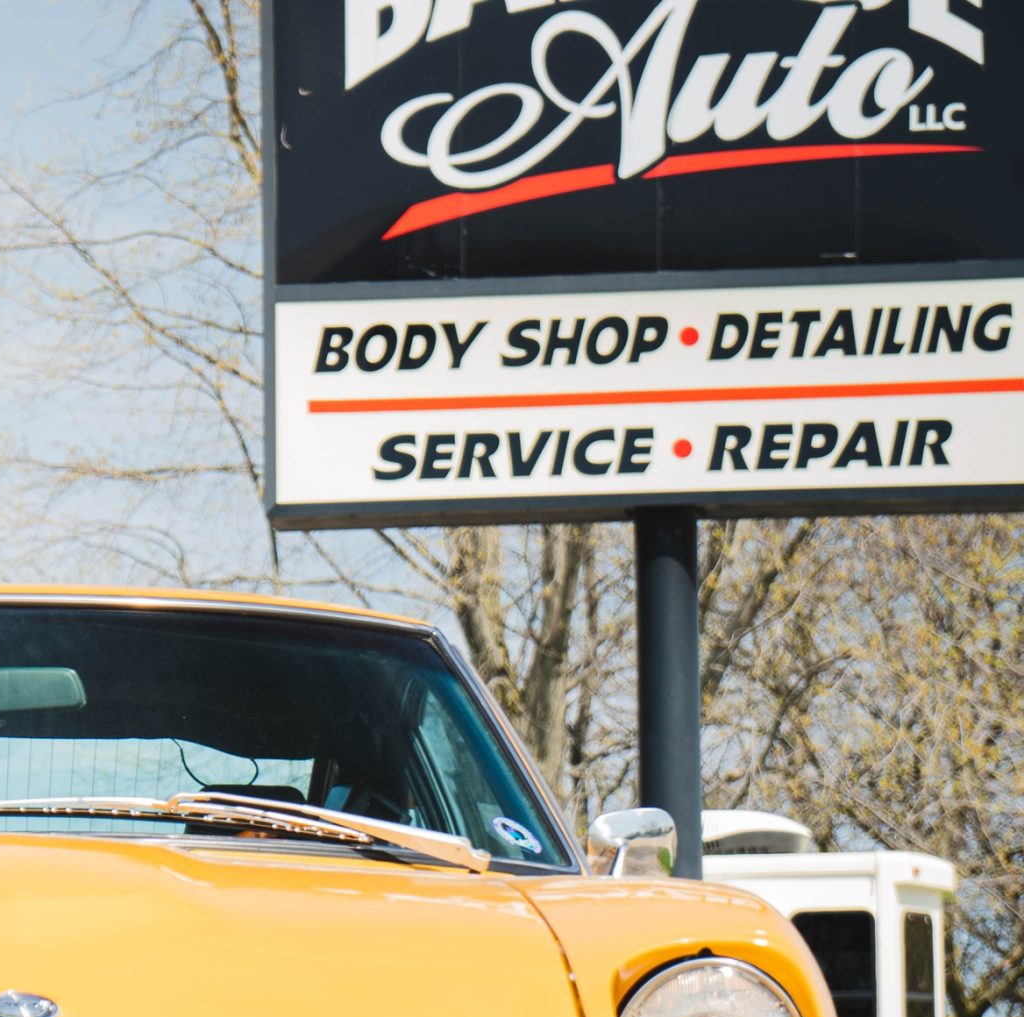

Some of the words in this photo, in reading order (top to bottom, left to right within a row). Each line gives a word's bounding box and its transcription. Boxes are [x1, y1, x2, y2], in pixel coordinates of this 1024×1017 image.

[380, 0, 934, 189] Auto
[908, 101, 967, 132] LLC
[314, 320, 488, 374] BODY
[501, 315, 669, 368] SHOP
[708, 302, 1013, 362] DETAILING
[373, 427, 655, 481] SERVICE
[707, 419, 954, 472] REPAIR
